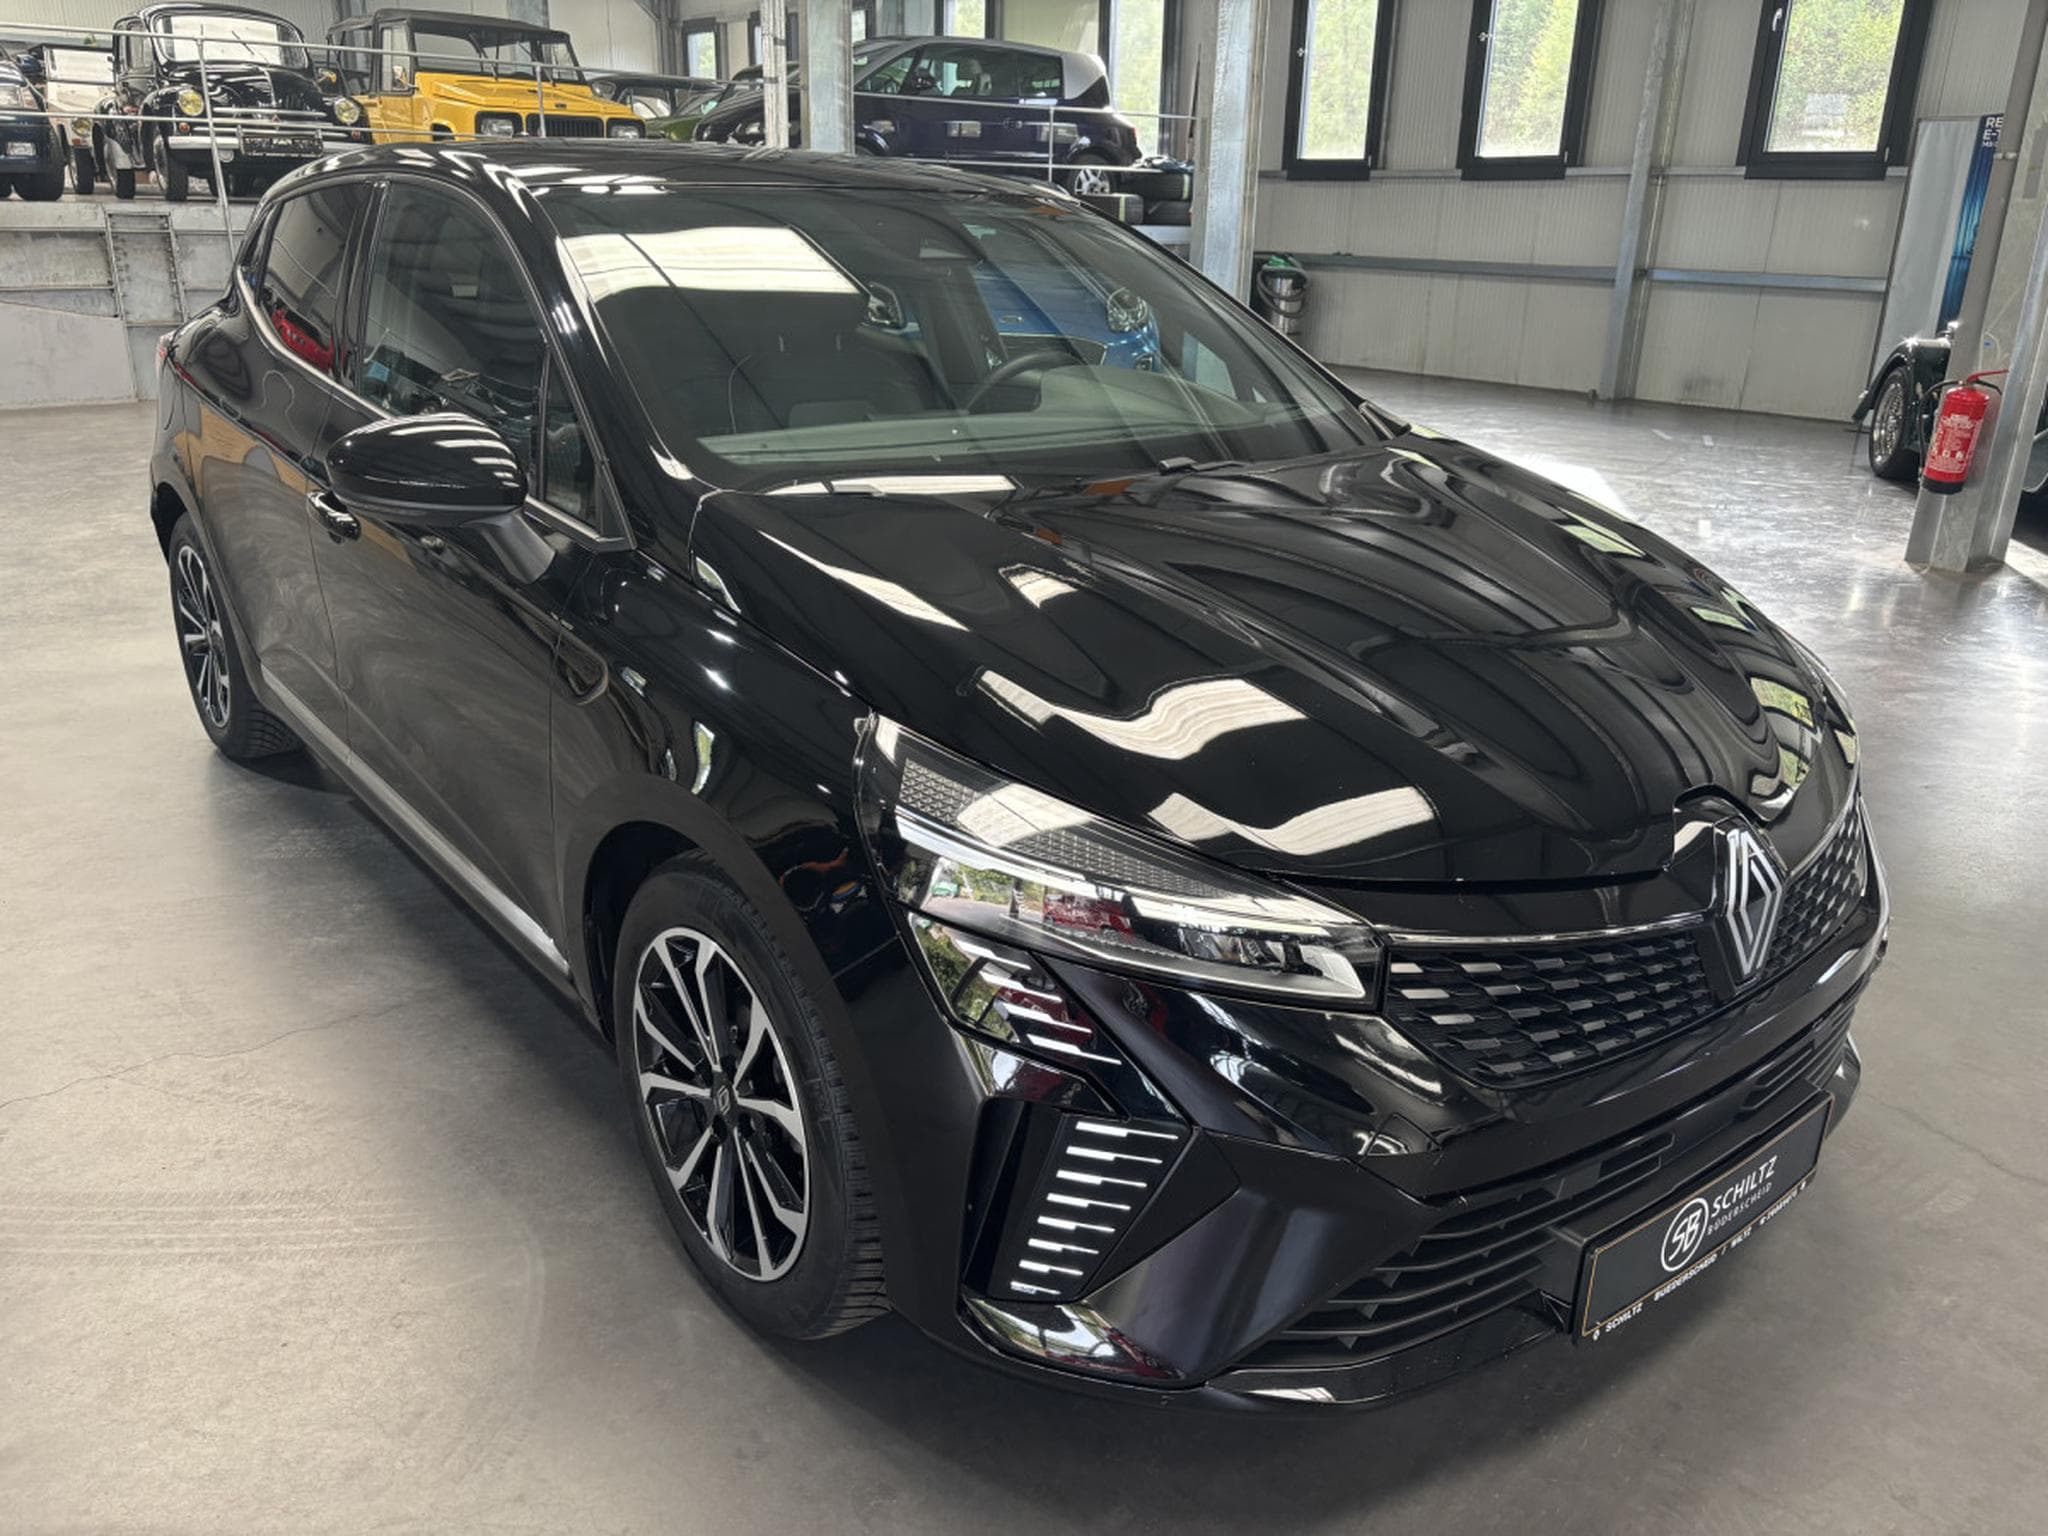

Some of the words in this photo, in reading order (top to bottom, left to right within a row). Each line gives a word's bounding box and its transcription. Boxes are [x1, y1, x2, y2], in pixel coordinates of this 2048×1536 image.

[1711, 1155, 1777, 1217] SCHILTZ
[1668, 1208, 1703, 1262] SB
[1605, 1302, 1643, 1332] SCHILTZ
